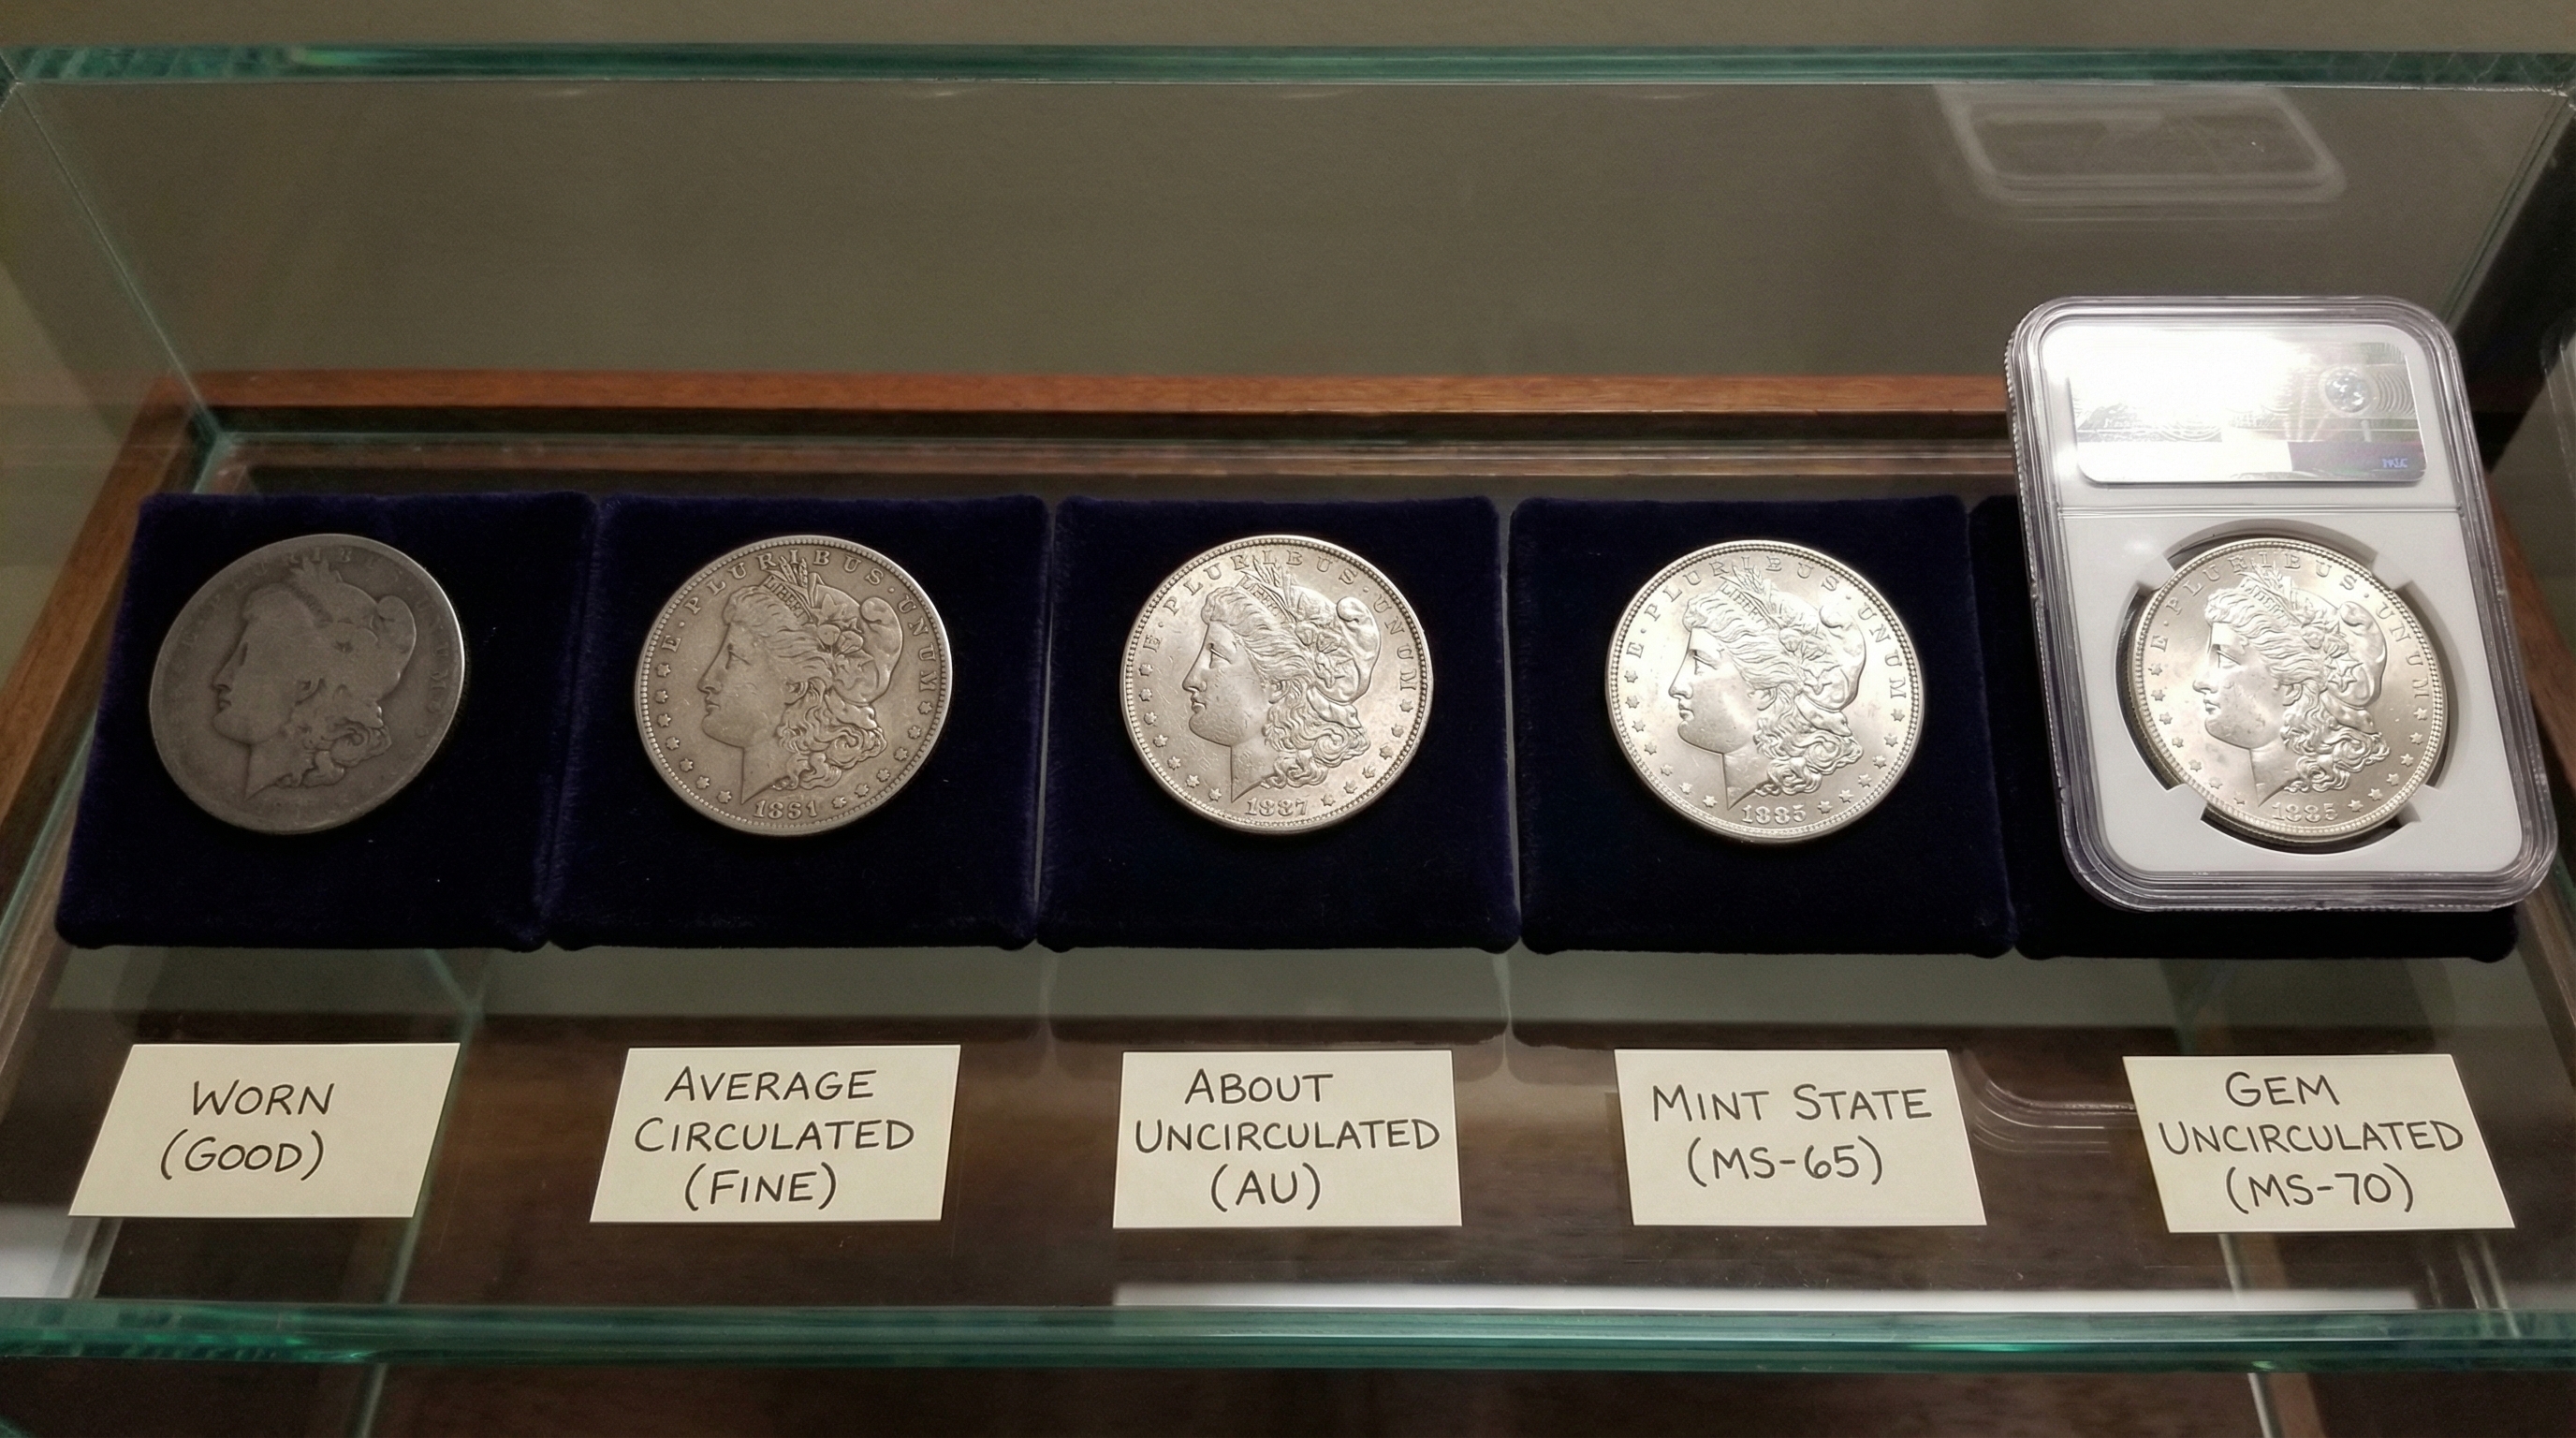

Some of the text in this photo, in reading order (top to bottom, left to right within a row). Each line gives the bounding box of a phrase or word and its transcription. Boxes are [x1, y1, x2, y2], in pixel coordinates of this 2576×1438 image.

[662, 549, 941, 692] E PLURIBUS UNUM
[1143, 549, 1420, 692] E PLURIBUS UNUM
[1625, 556, 1908, 700] E PLURIBUS UNUM
[2150, 634, 2170, 653] E
[2167, 551, 2358, 616] PLURIBUS
[2375, 602, 2431, 699] UNUM
[1245, 797, 1309, 817] 1887
[1741, 804, 1807, 825] 1885
[2271, 801, 2339, 823] 1885
[193, 1078, 335, 1116] WORN
[664, 1066, 877, 1102] AVERAGE
[1184, 1068, 1334, 1105] ABOUT
[1652, 1083, 1932, 1122] MINT STATE
[2225, 1071, 2340, 1108] GEM
[635, 1117, 915, 1152] CIRCULATED
[1135, 1119, 1440, 1153] UNCIRCULATED
[2158, 1120, 2464, 1155] UNCIRCULATED
[160, 1128, 324, 1181] (GOOD)
[1688, 1136, 1882, 1188] (MS-65)
[684, 1162, 837, 1211] (FINE)
[1210, 1162, 1321, 1212] (AU)
[2226, 1163, 2414, 1215] (MS-70)
